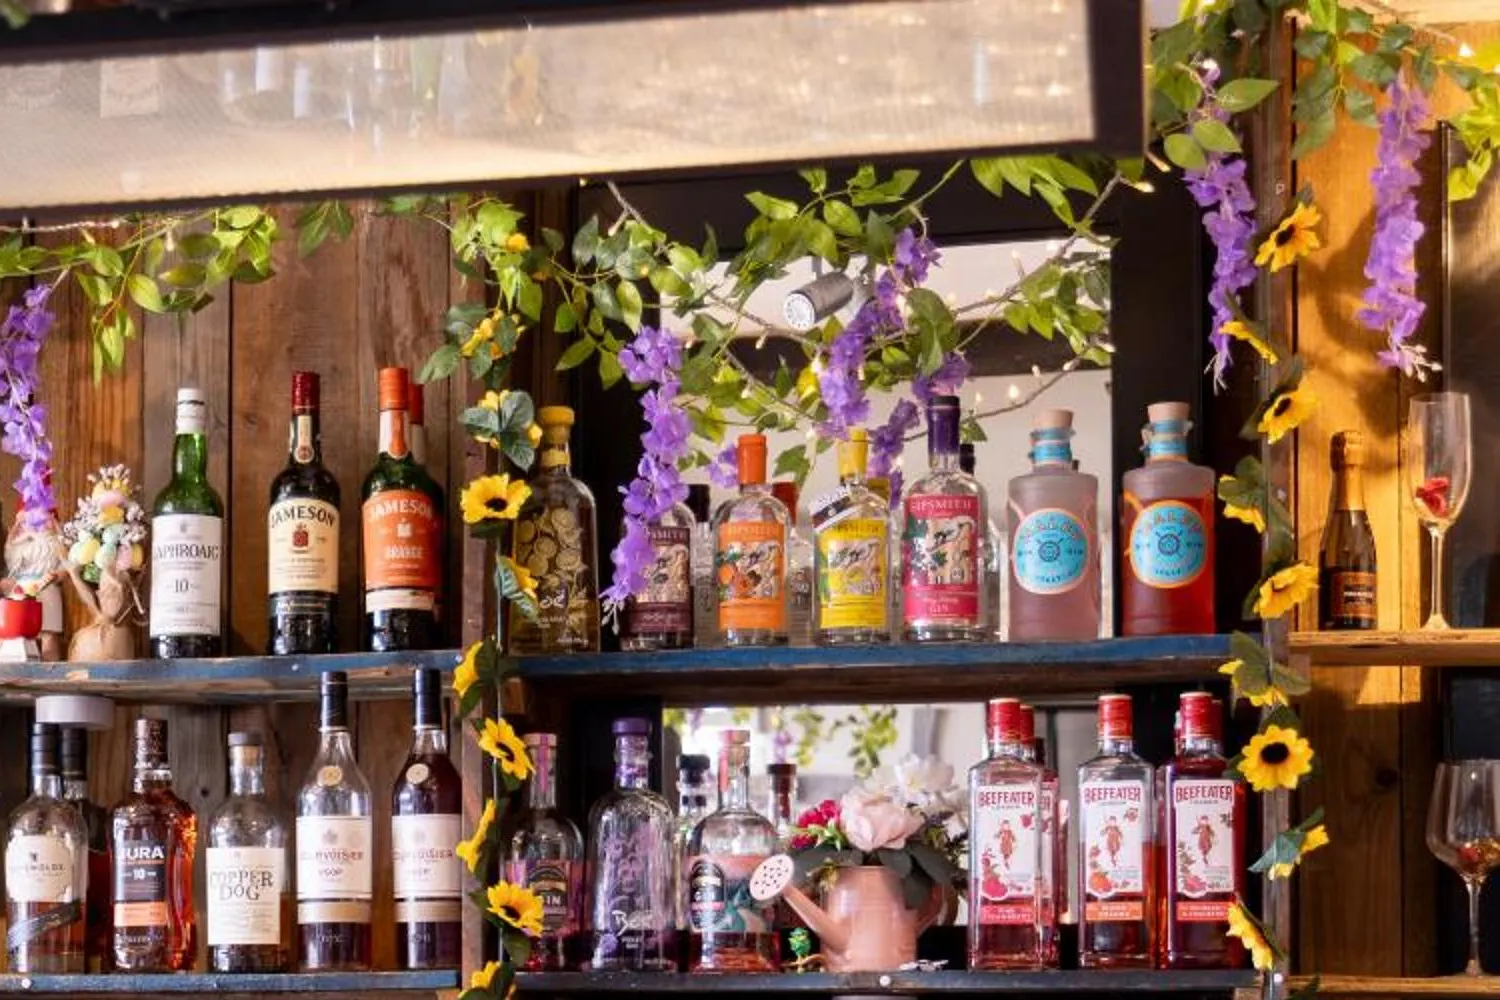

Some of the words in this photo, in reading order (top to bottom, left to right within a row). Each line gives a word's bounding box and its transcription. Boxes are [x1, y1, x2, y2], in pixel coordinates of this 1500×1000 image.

[271, 504, 335, 528] JAMESON
[371, 499, 433, 519] JAMESON
[174, 579, 190, 593] 10
[979, 790, 1036, 807] BEEFEATER
[1085, 786, 1141, 801] BEEFEATER
[1176, 785, 1233, 800] BEEFEATER
[121, 845, 165, 860] JURA
[210, 870, 274, 887] COPPER
[219, 884, 260, 901] DOG
